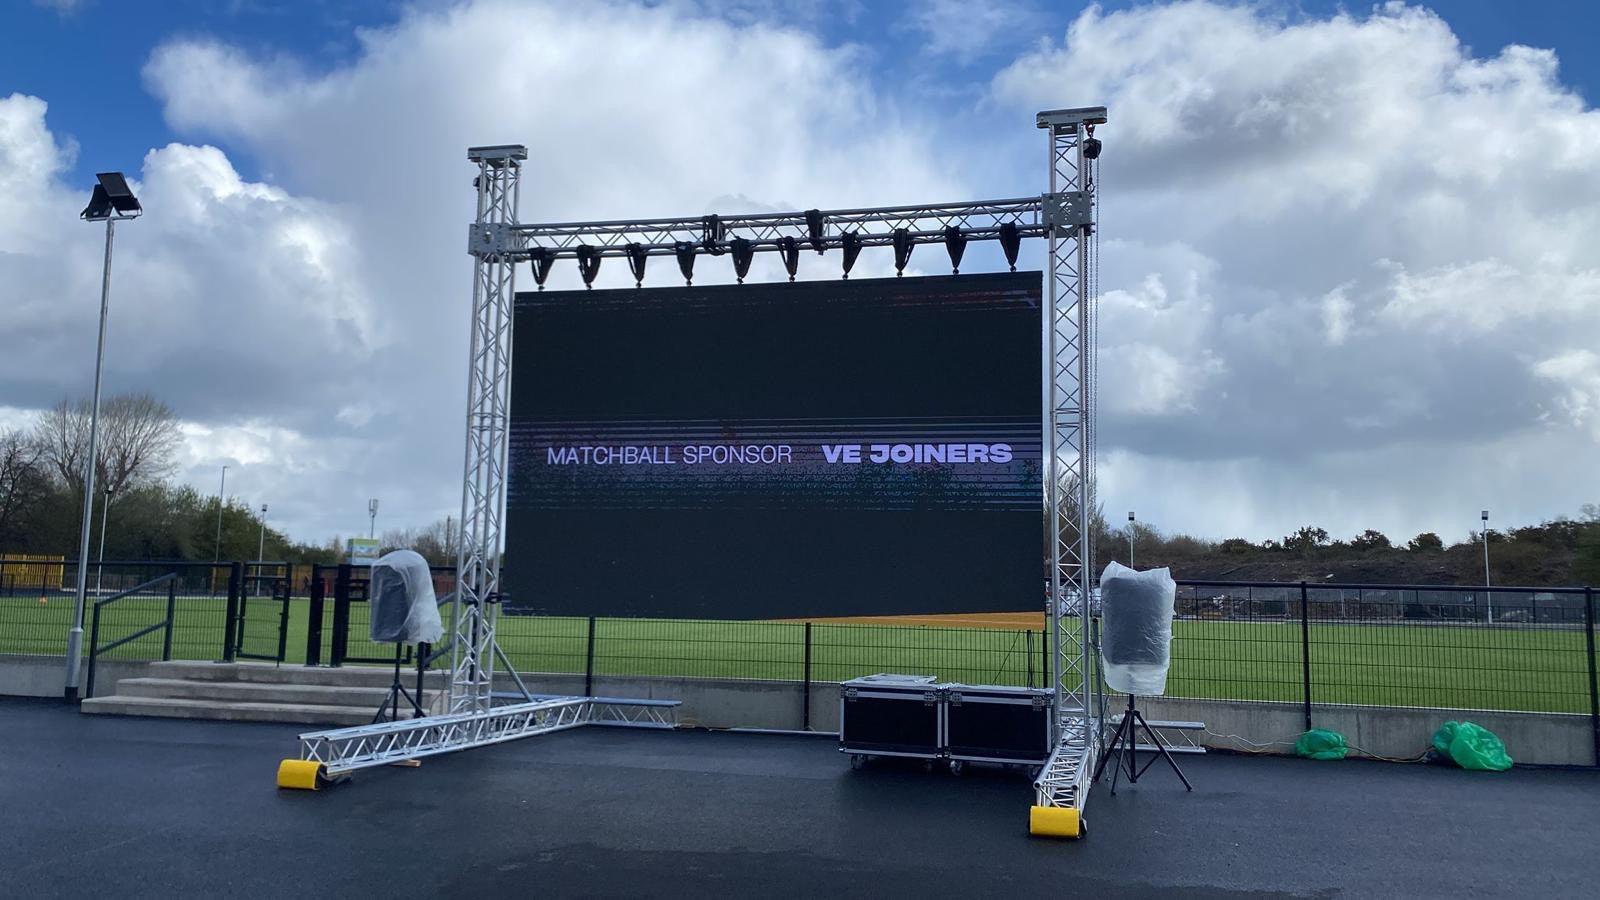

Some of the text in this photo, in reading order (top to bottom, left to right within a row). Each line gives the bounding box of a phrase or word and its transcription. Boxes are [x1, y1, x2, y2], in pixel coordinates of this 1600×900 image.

[547, 443, 1013, 465] MATCHBALL SPONSOR VE JOINERS
